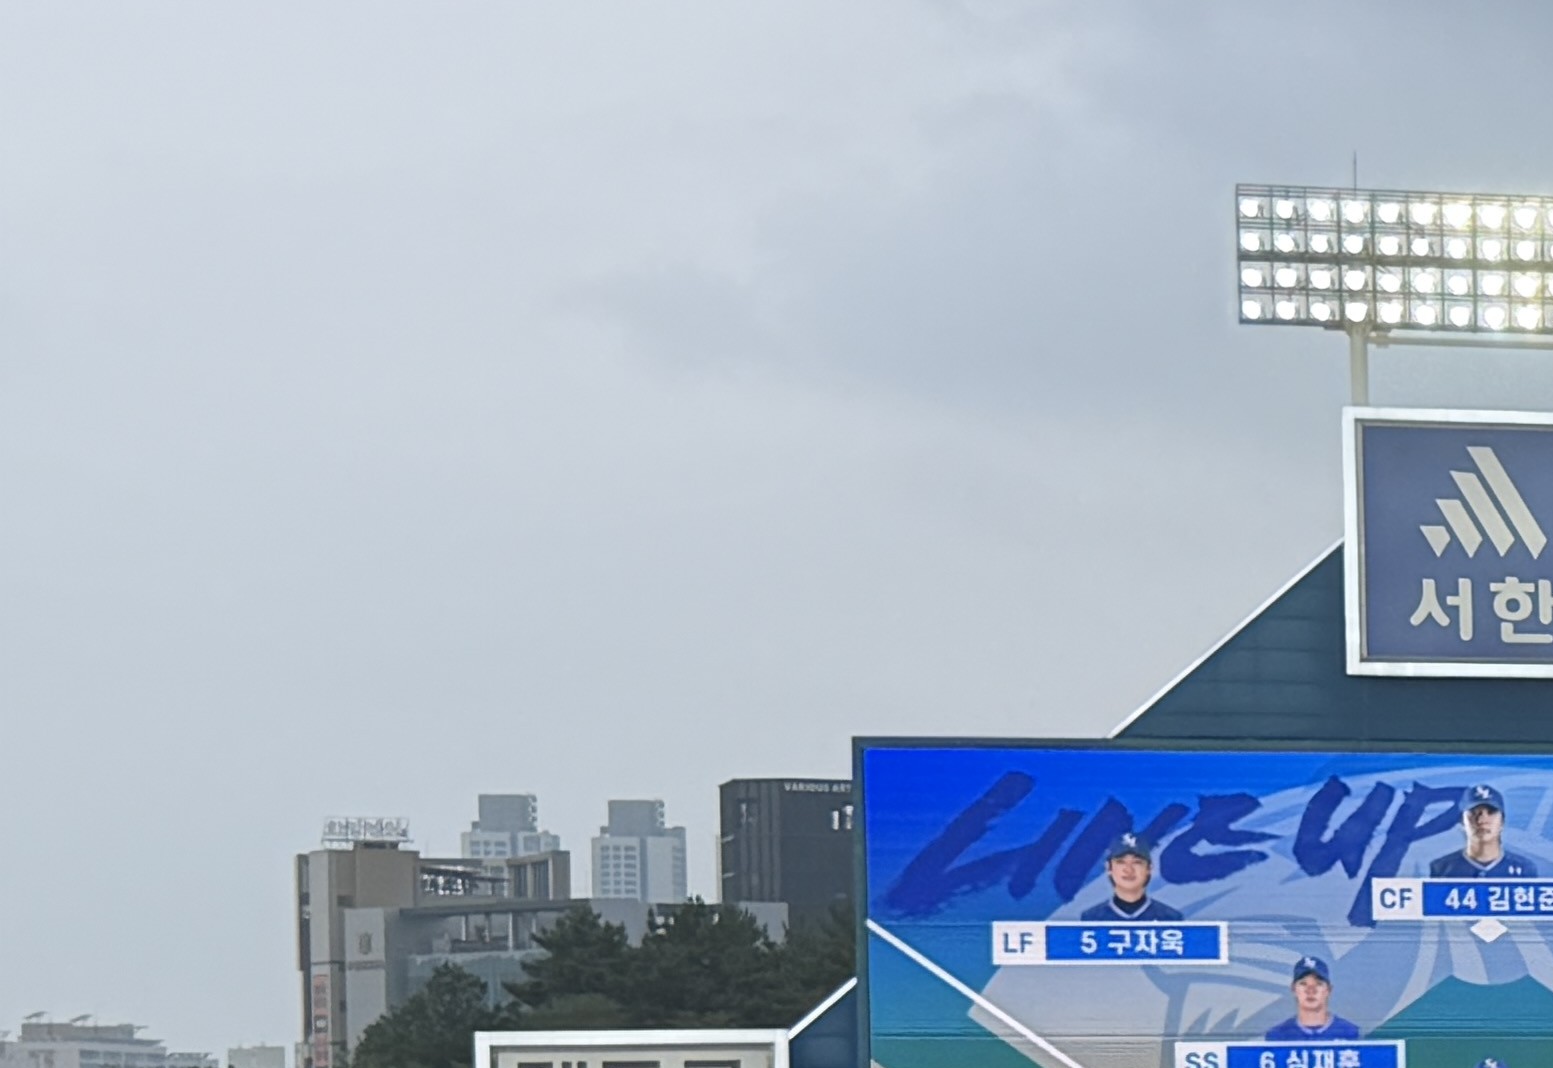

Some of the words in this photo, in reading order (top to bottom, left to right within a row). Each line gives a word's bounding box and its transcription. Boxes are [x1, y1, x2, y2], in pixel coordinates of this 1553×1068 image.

[886, 770, 1284, 920] LINE
[1291, 774, 1466, 928] UP
[1379, 887, 1413, 909] CF
[1445, 886, 1477, 910] 44
[1002, 933, 1033, 954] LF
[1080, 931, 1098, 953] 5
[1106, 928, 1185, 957] 구자욱
